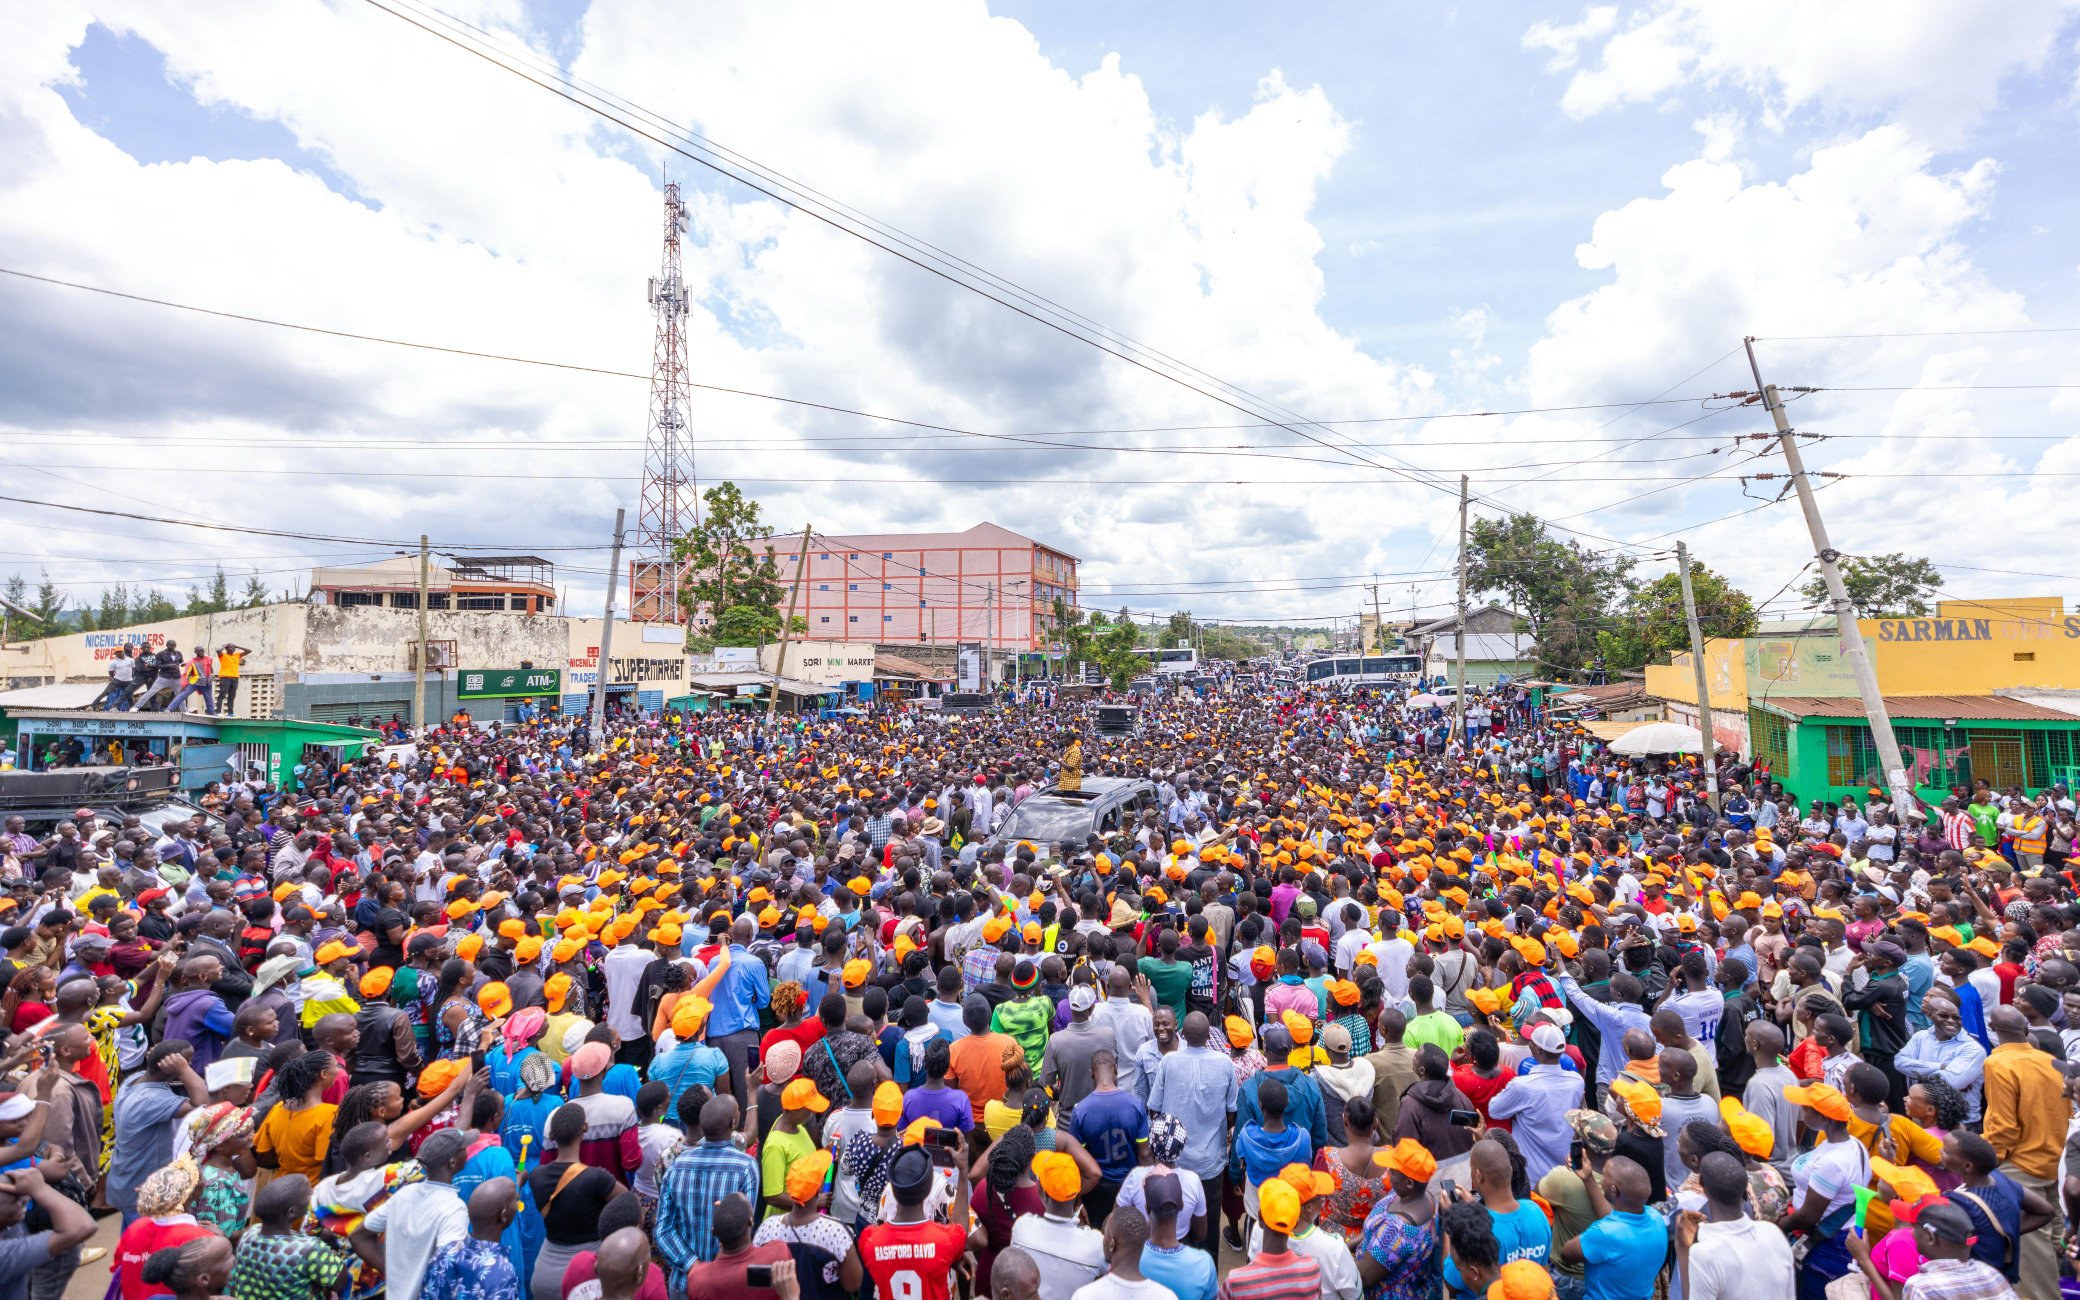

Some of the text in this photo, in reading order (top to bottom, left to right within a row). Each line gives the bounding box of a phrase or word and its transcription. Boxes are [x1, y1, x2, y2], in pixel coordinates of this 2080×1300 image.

[1878, 619, 1992, 642] SARMAN
[85, 633, 165, 648] NICENILE TRADERS
[569, 658, 597, 668] NICENILE
[803, 657, 875, 667] SORI MINI MARKET
[614, 658, 685, 682] SUPERMARKET
[1388, 672, 1419, 680] GALAXY
[526, 675, 549, 687] ATM
[570, 672, 598, 683] TRADER
[127, 721, 146, 730] SHADE
[1192, 956, 1215, 968] ANT
[1099, 1128, 1128, 1163] 12
[874, 1242, 936, 1261] RASHFORD DAVID
